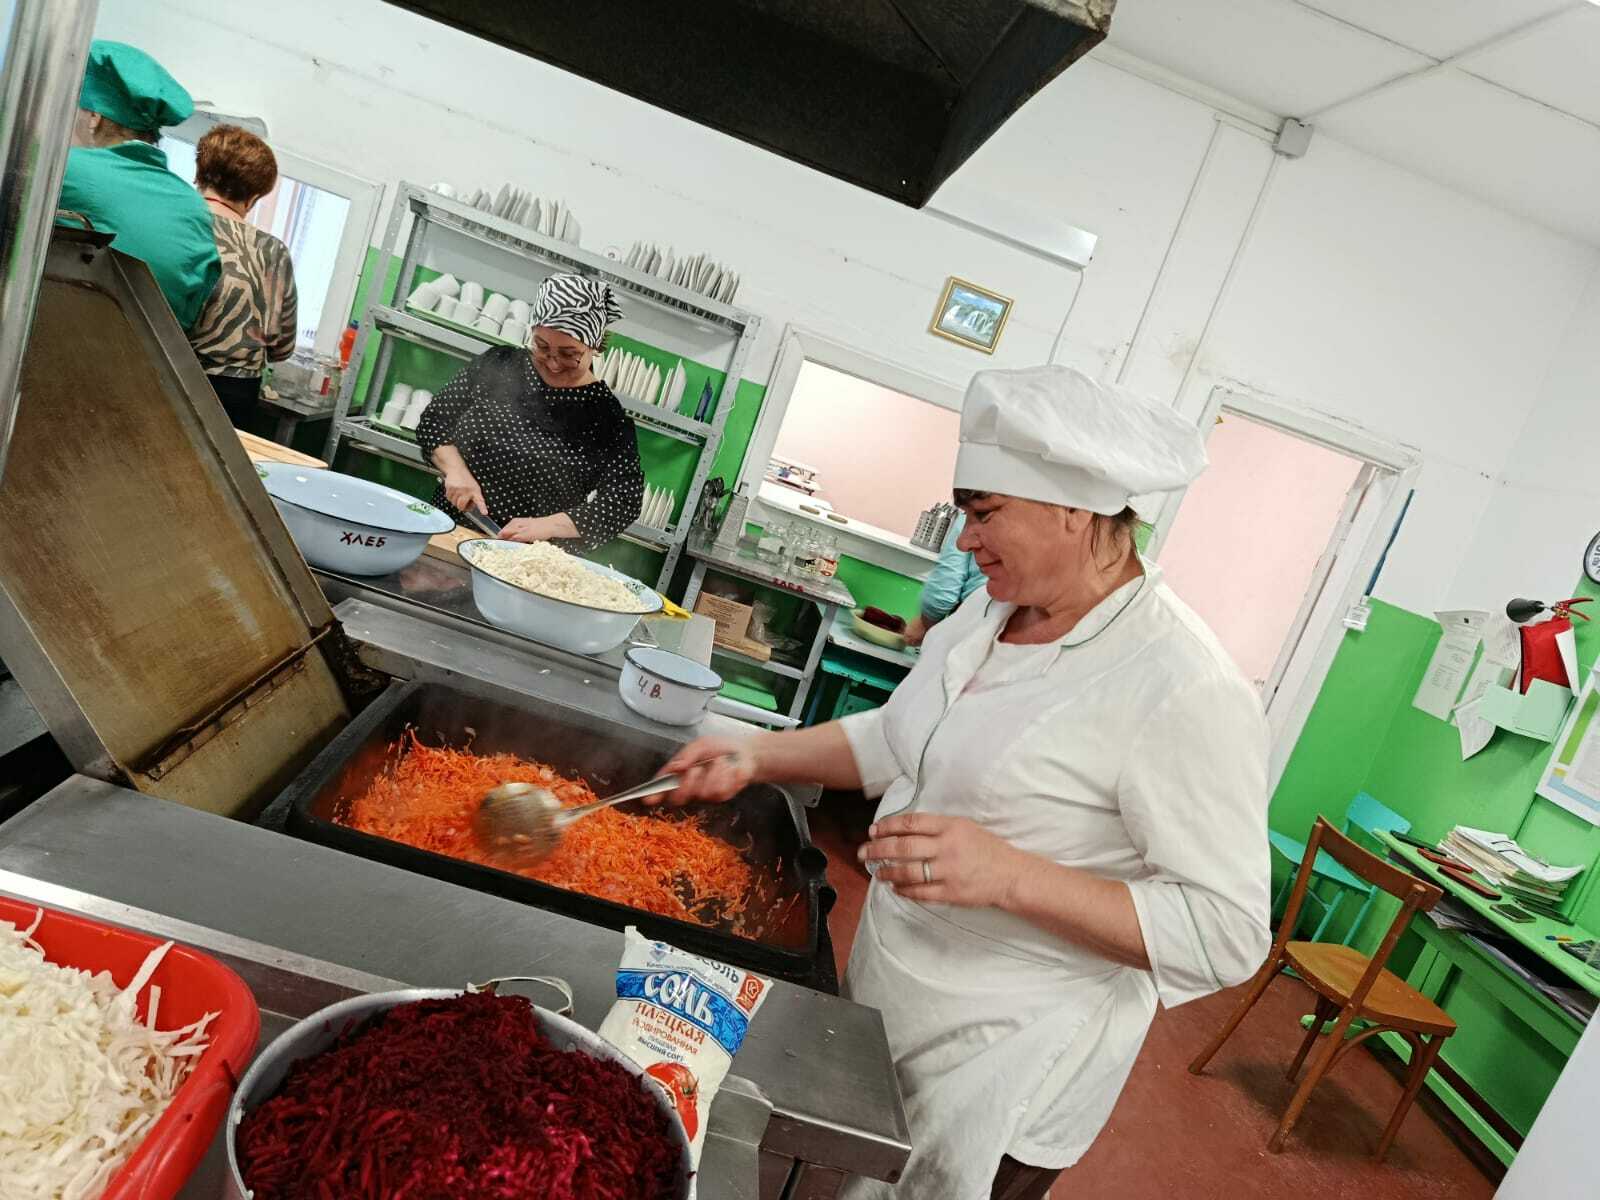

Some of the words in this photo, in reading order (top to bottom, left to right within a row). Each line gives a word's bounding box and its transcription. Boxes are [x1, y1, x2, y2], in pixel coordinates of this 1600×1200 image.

[340, 531, 387, 548] ХЛЕБ
[644, 971, 714, 1025] СОЛЬ
[635, 1002, 705, 1045] ИЛЕЦКАЯ
